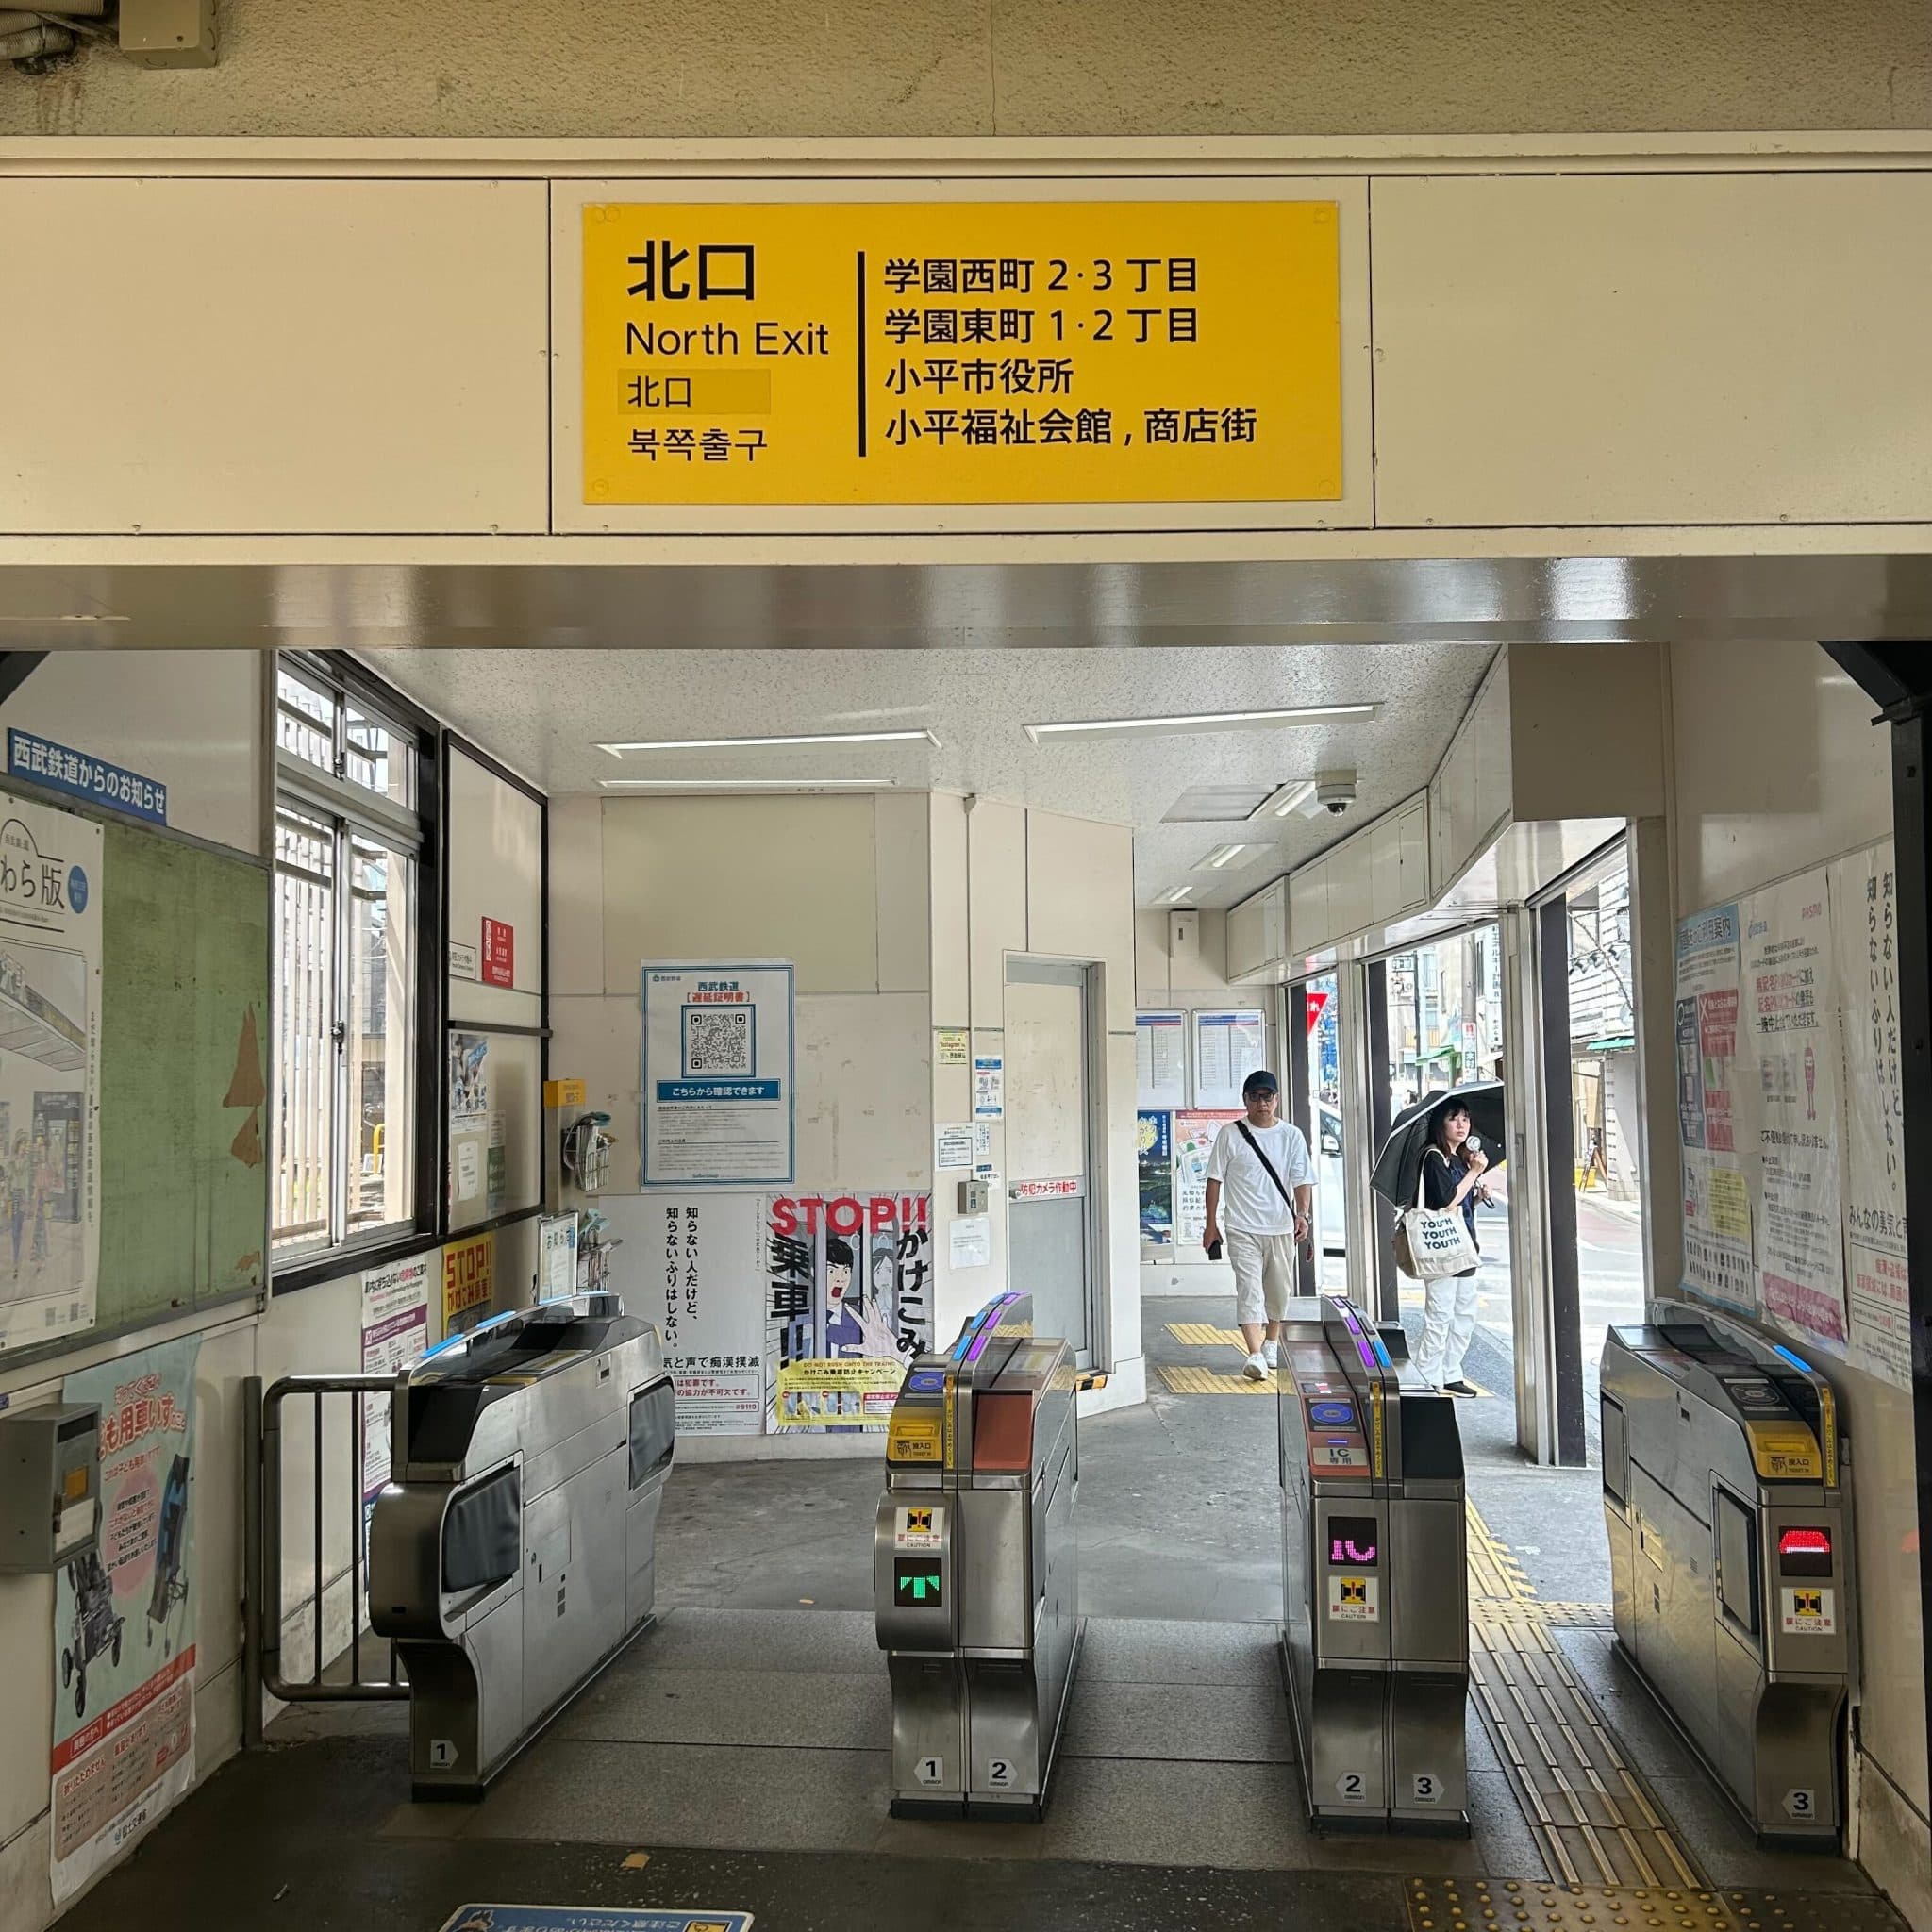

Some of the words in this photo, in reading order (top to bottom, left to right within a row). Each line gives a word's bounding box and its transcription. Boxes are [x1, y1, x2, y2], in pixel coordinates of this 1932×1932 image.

[627, 240, 755, 302] 北口
[626, 322, 739, 356] North
[755, 322, 829, 356] Exit
[885, 358, 1074, 395] 小平市役所
[627, 375, 691, 408] 北口
[1143, 407, 1257, 444] 商店街
[627, 428, 768, 462] 북쪽출구
[13, 735, 165, 814] 西武鉄道からのお知らせ
[697, 981, 740, 991] 西武鉄道
[672, 1086, 765, 1097] こちらから確認できます
[771, 1197, 931, 1236] STOP!!
[1422, 1226, 1457, 1240] YOUTH
[1424, 1237, 1461, 1250] YOUTH
[686, 1207, 699, 1320] 知らない人だけど、
[666, 1207, 679, 1348] 知らないふりはしない。
[896, 1228, 931, 1359] かけこみ
[1329, 1448, 1350, 1457] IC
[436, 1743, 446, 1760] 1
[925, 1760, 936, 1777] 1
[991, 1762, 1007, 1779] 2
[1345, 1774, 1361, 1792] 2
[1417, 1777, 1432, 1795] 3
[1793, 1791, 1809, 1811] 3
